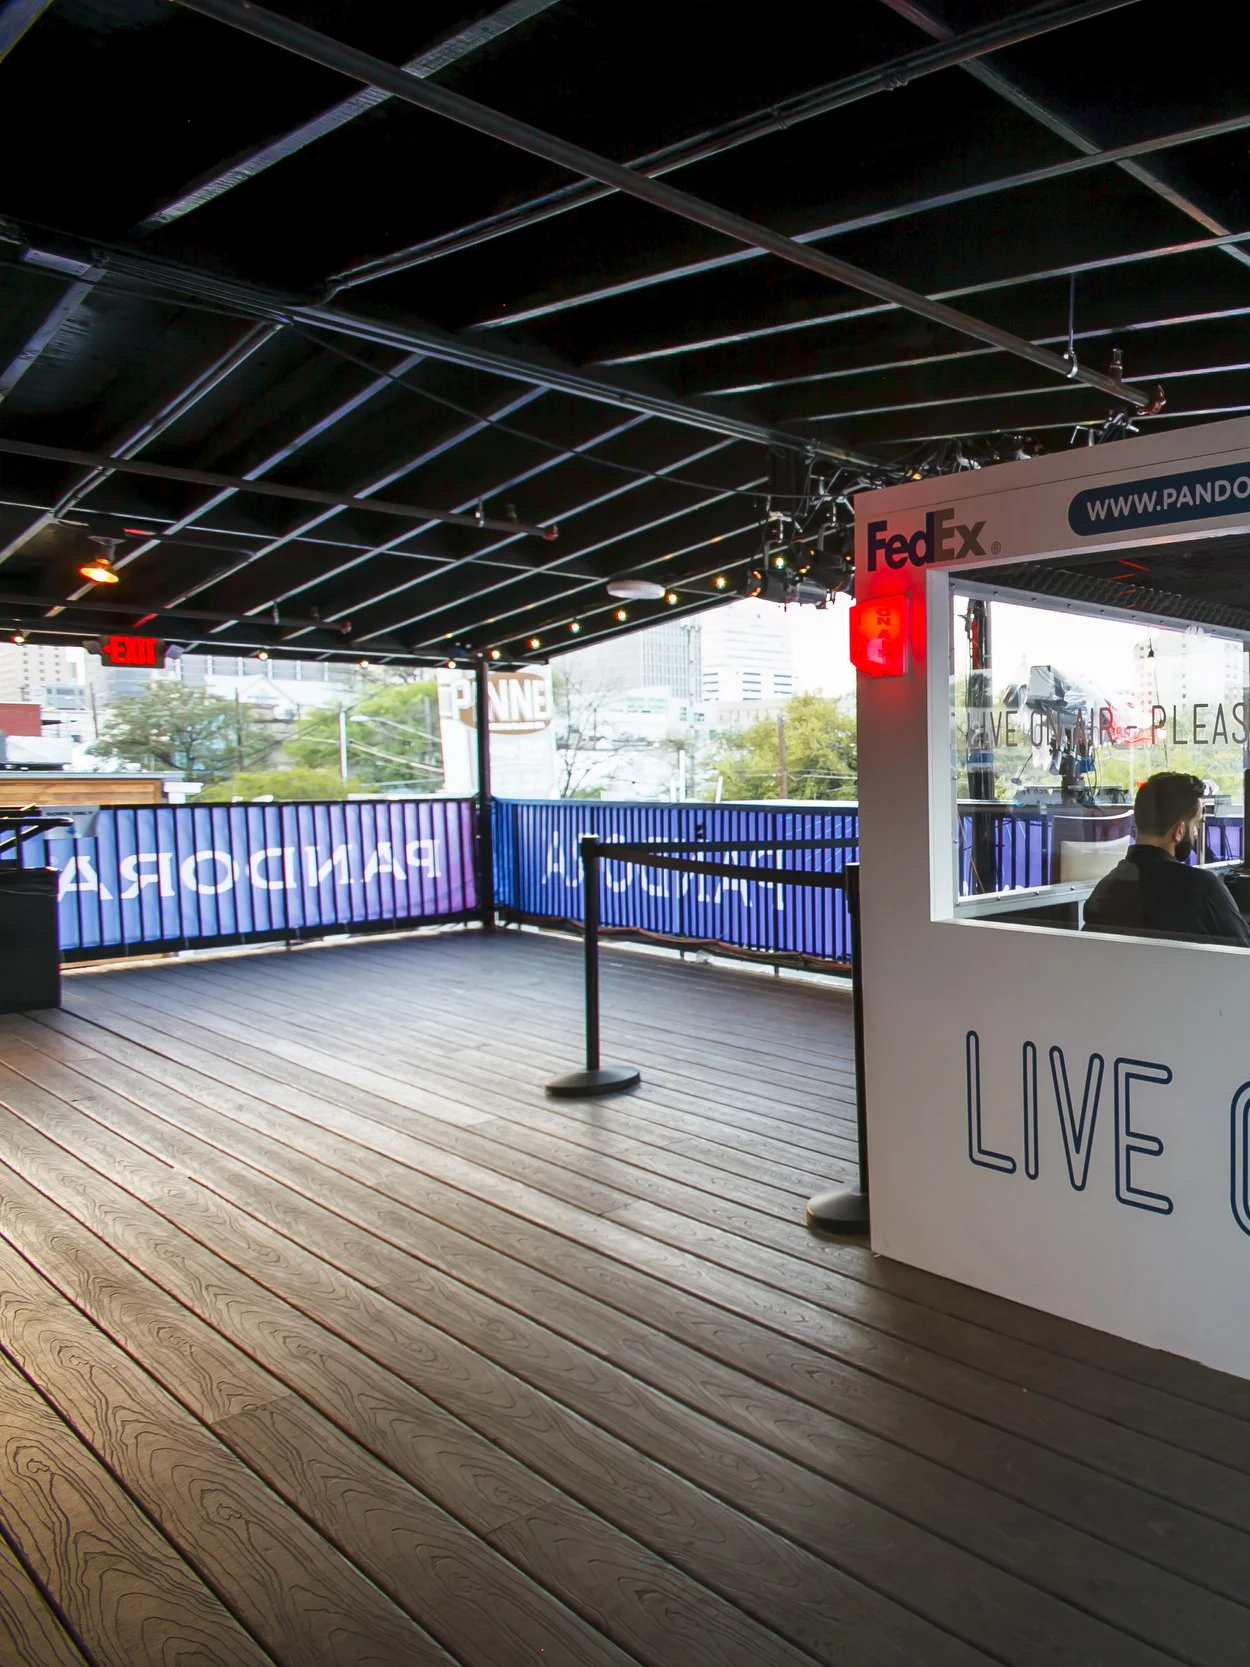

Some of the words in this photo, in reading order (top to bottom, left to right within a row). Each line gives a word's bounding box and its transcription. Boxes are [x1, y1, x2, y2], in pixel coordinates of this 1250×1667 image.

[867, 507, 987, 572] FedEx
[108, 634, 158, 666] EXIT
[967, 709, 1018, 748] LIVE
[1030, 708, 1062, 748] ON
[1072, 706, 1116, 747] AIR
[965, 1029, 1174, 1216] LIVE
